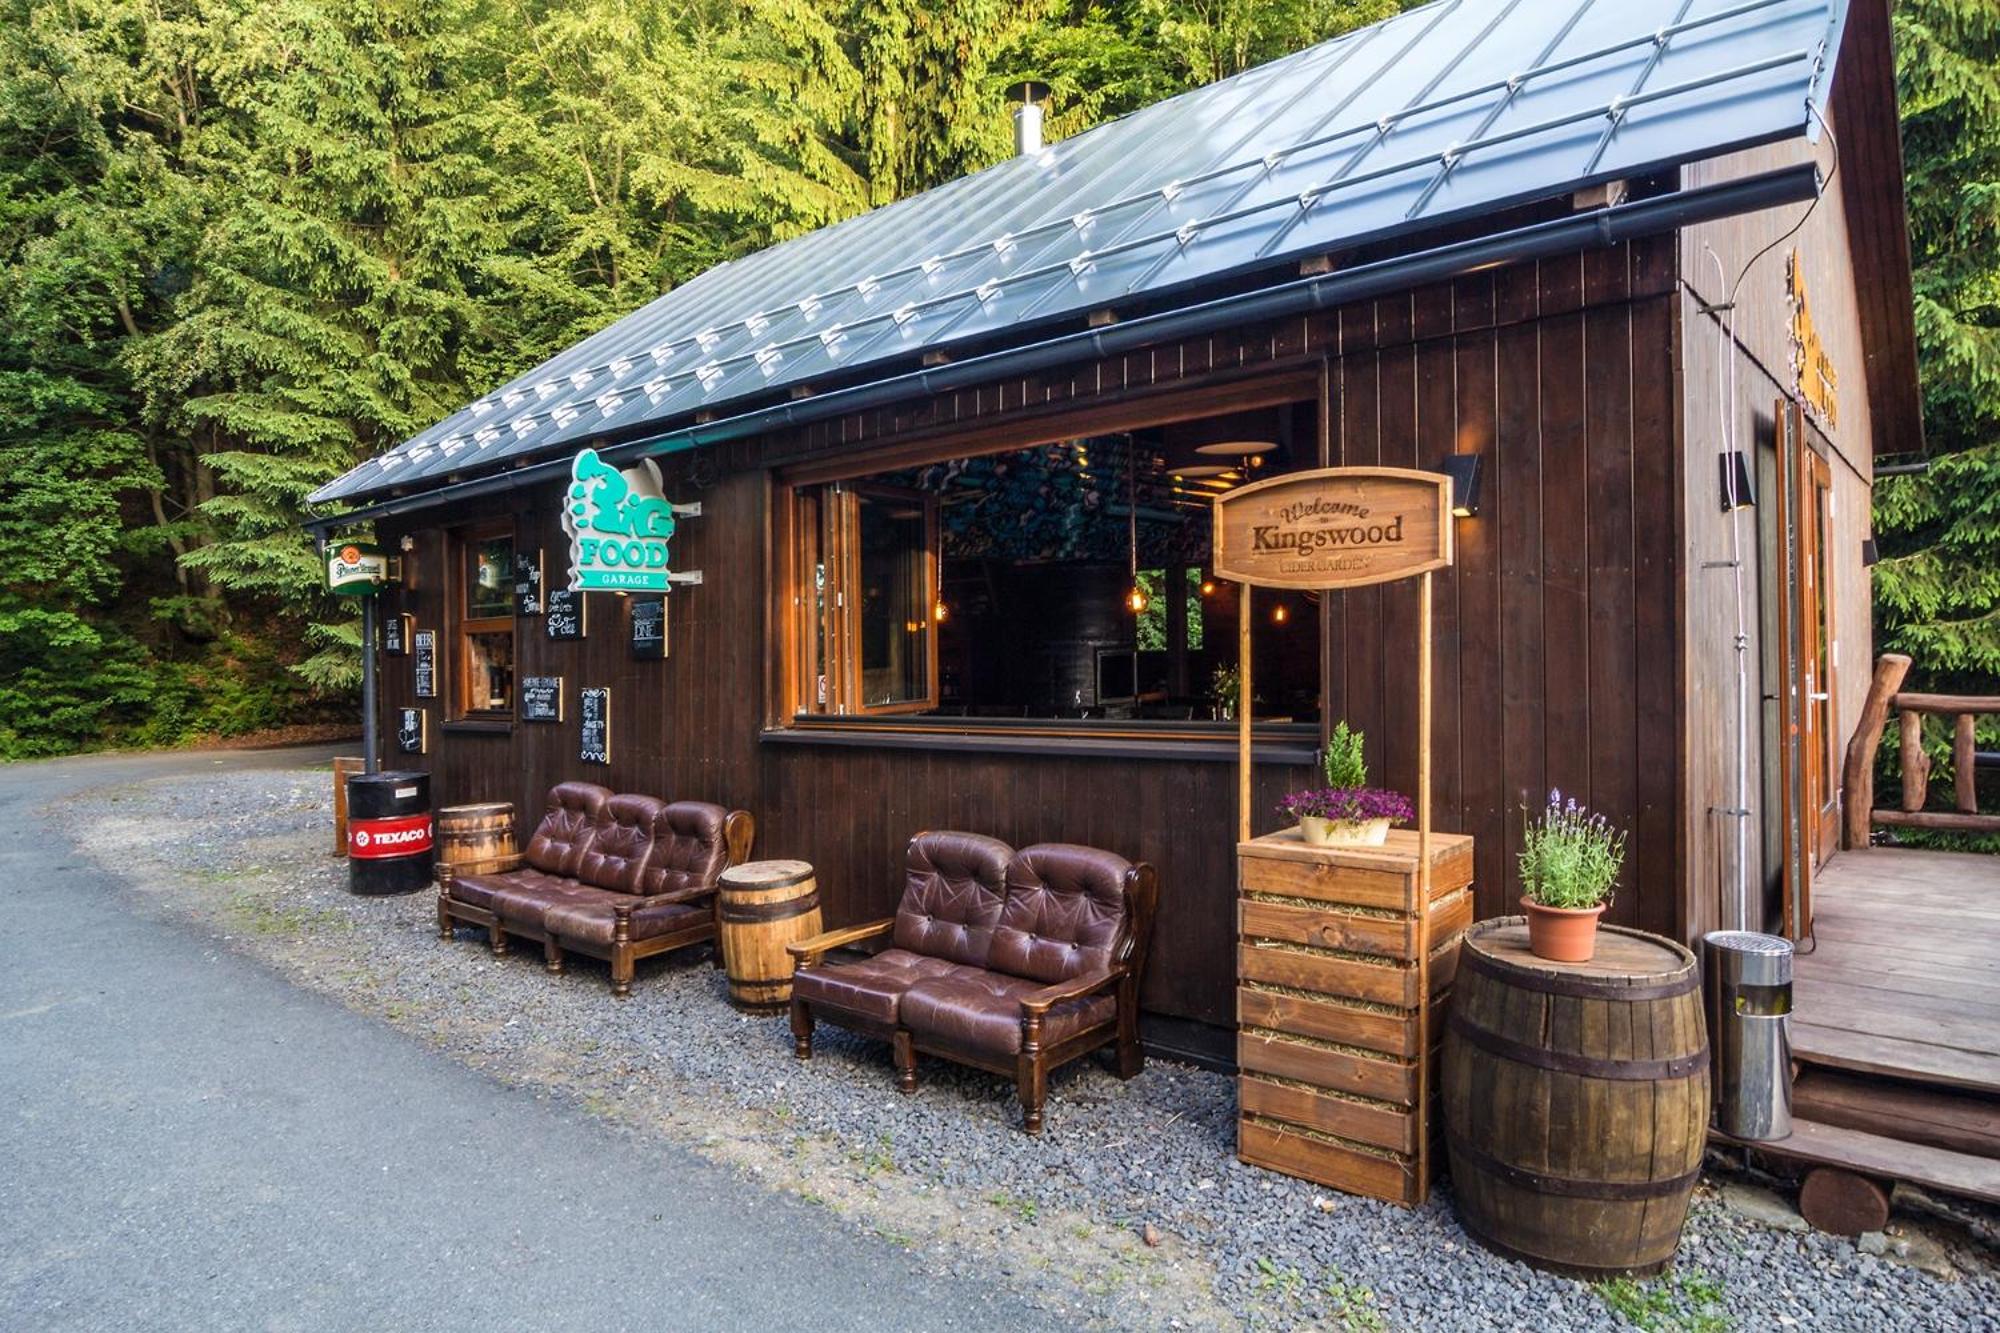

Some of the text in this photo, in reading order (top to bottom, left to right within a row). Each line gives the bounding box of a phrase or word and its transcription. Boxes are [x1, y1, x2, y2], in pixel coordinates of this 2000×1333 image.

[1281, 497, 1370, 524] Welcome
[1252, 515, 1404, 556] Kingswood
[579, 538, 669, 568] FOOD
[602, 574, 650, 586] GARAGE
[373, 828, 425, 845] TEXACO
